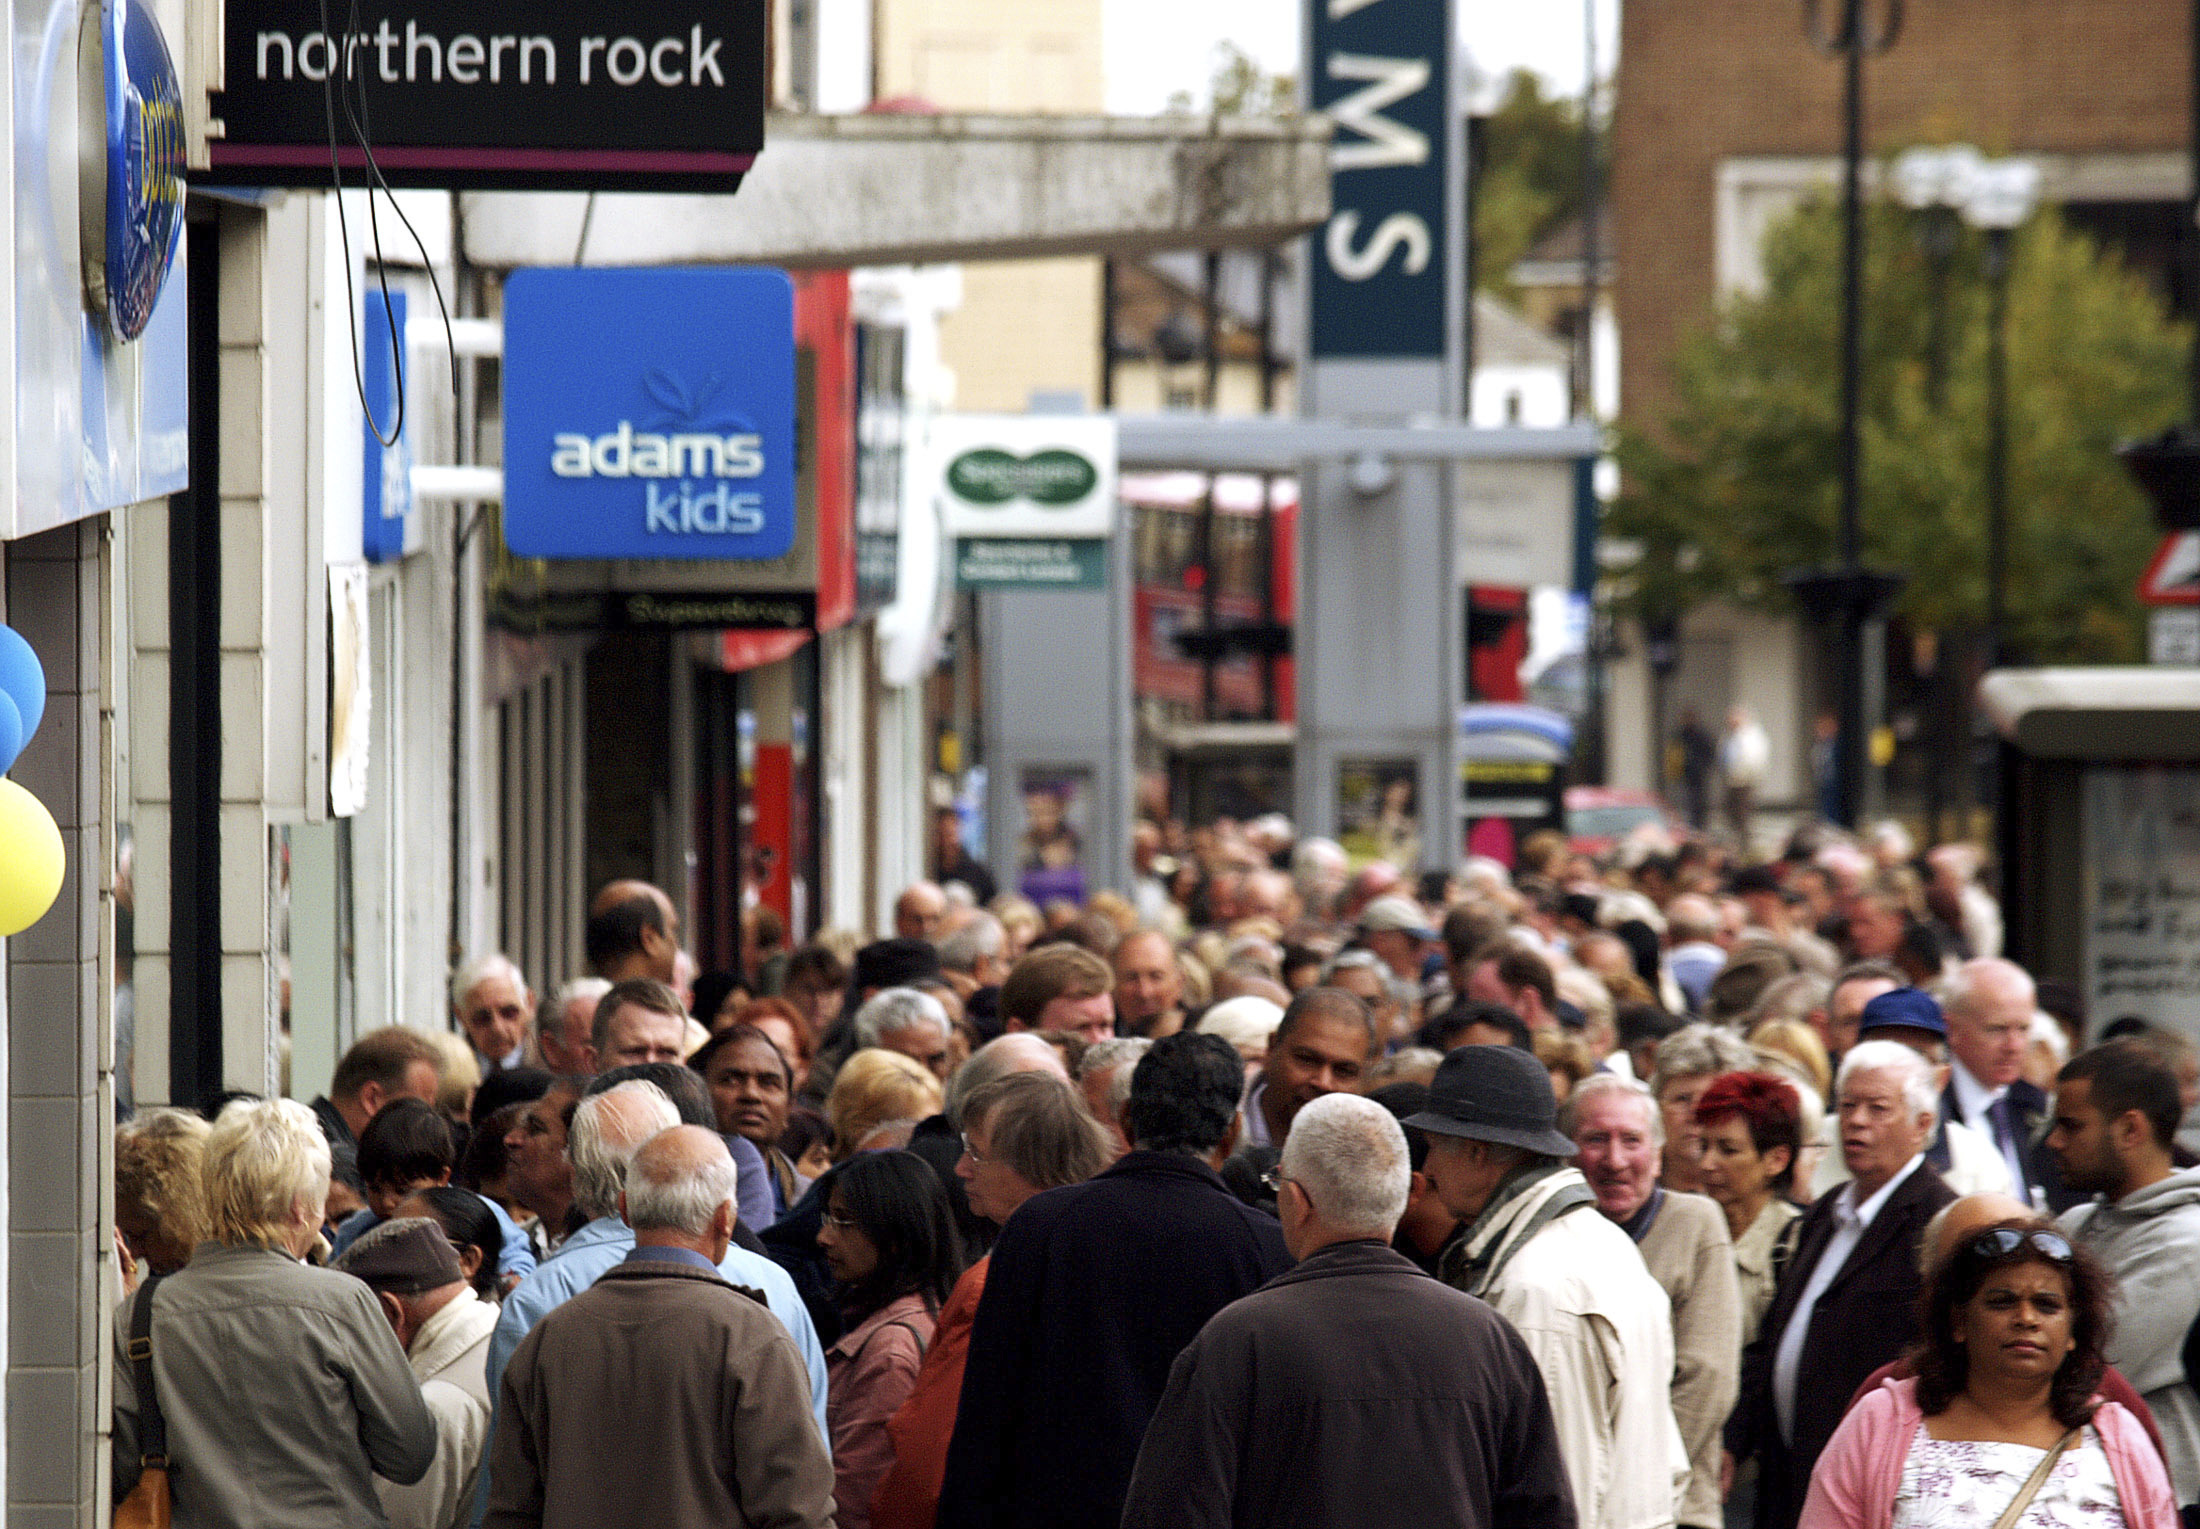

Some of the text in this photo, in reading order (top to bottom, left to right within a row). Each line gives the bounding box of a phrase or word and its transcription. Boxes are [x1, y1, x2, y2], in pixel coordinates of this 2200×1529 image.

[256, 19, 725, 87] northern rock
[1326, 0, 1432, 281] MS
[551, 420, 764, 479] adams
[645, 481, 764, 534] kids
